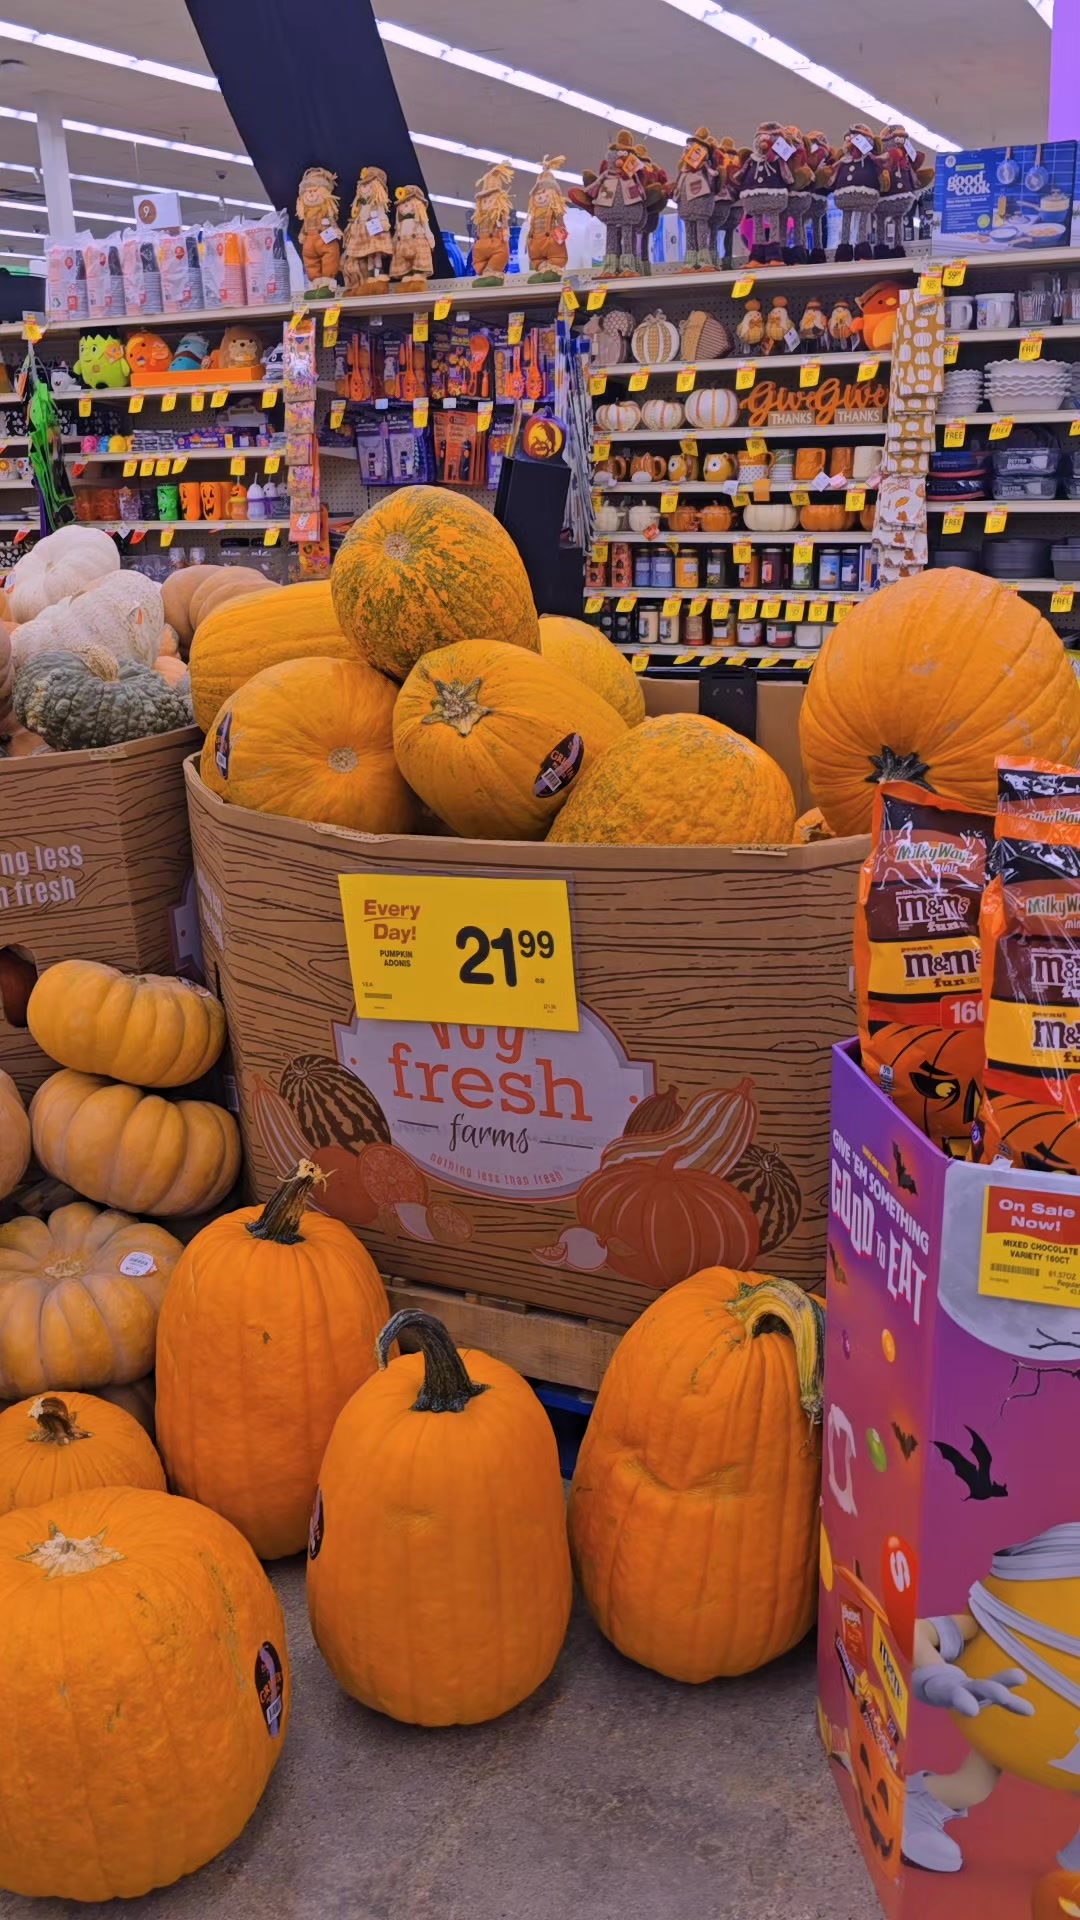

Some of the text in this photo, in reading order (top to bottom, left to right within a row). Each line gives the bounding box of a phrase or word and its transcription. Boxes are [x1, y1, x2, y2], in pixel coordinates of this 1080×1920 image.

[947, 171, 985, 191] good
[955, 181, 991, 195] cook
[770, 413, 812, 425] THANKS
[837, 410, 880, 422] THANKS
[945, 431, 963, 440] FREE
[944, 518, 961, 526] FREE
[35, 845, 83, 871] less
[14, 876, 76, 906] fresh
[364, 899, 421, 920] Every
[373, 923, 416, 944] Day!
[379, 949, 413, 958] PUMPKIN
[383, 959, 411, 968] ADONIS
[933, 977, 965, 987] fun
[388, 1042, 593, 1121] fresh
[449, 1113, 529, 1154] farms
[429, 1152, 563, 1186] nothing less than fresh
[832, 1128, 850, 1164] GIVE
[868, 1172, 930, 1256] SOMETHING
[999, 1199, 1076, 1218] On Sale
[1011, 1215, 1061, 1232] Now!
[831, 1157, 875, 1256] GOOD
[887, 1229, 928, 1325] EAT
[1003, 1239, 1079, 1255] MIXED CHOCOLATE
[1010, 1249, 1070, 1265] VARIETY 160CT
